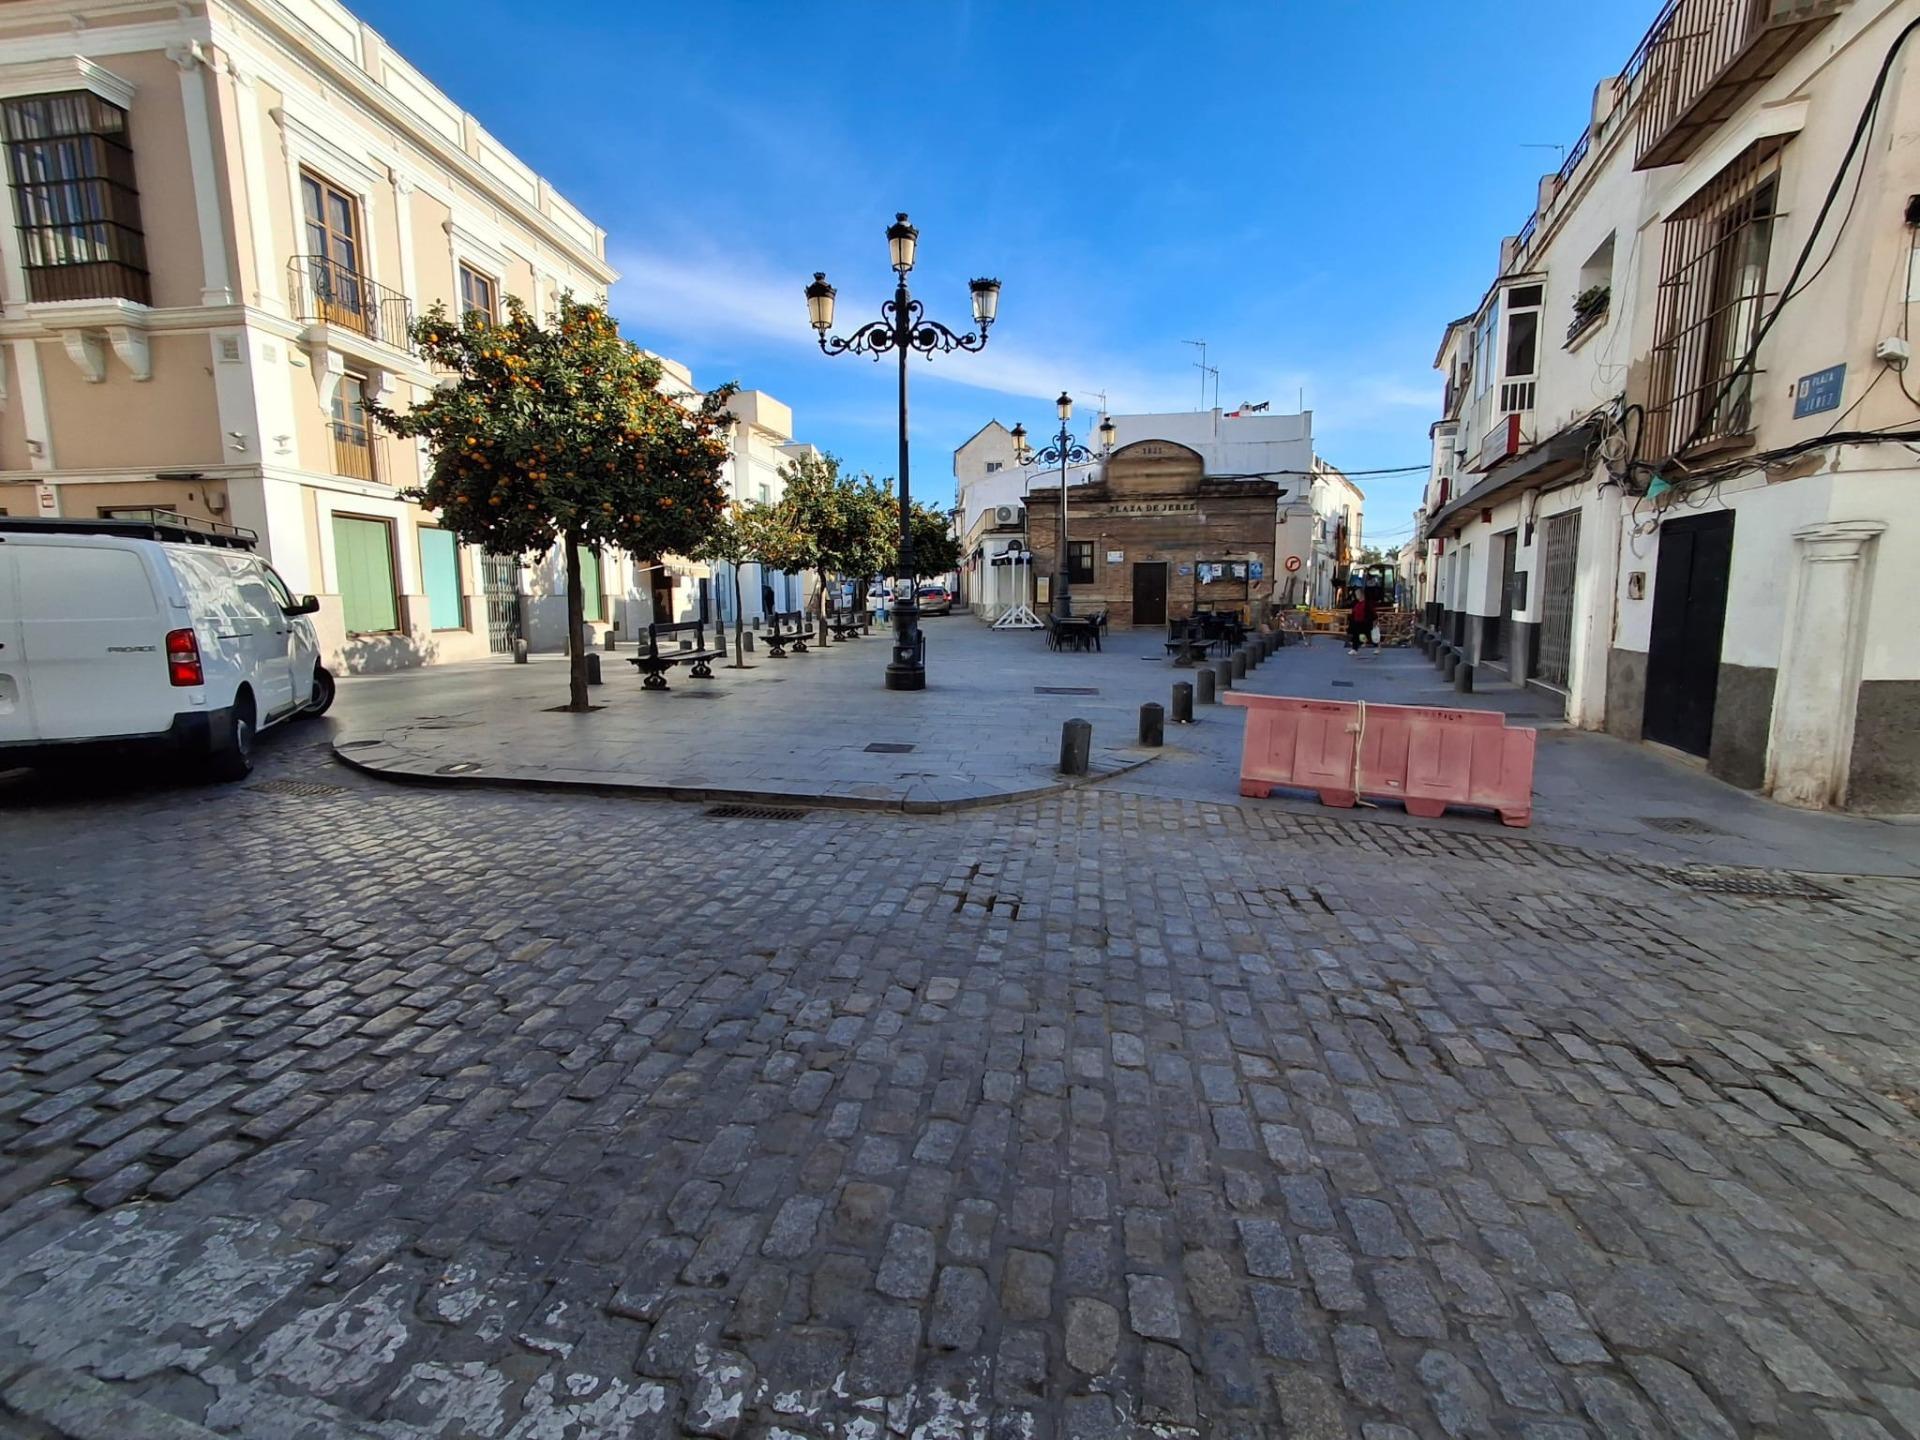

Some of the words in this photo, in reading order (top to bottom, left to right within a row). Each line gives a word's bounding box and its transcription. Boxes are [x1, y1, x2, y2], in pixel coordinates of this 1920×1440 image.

[1110, 504, 1142, 513] PLAZA
[1146, 504, 1159, 512] DE
[1162, 503, 1196, 512] JEREZ
[107, 645, 156, 653] PROACE
